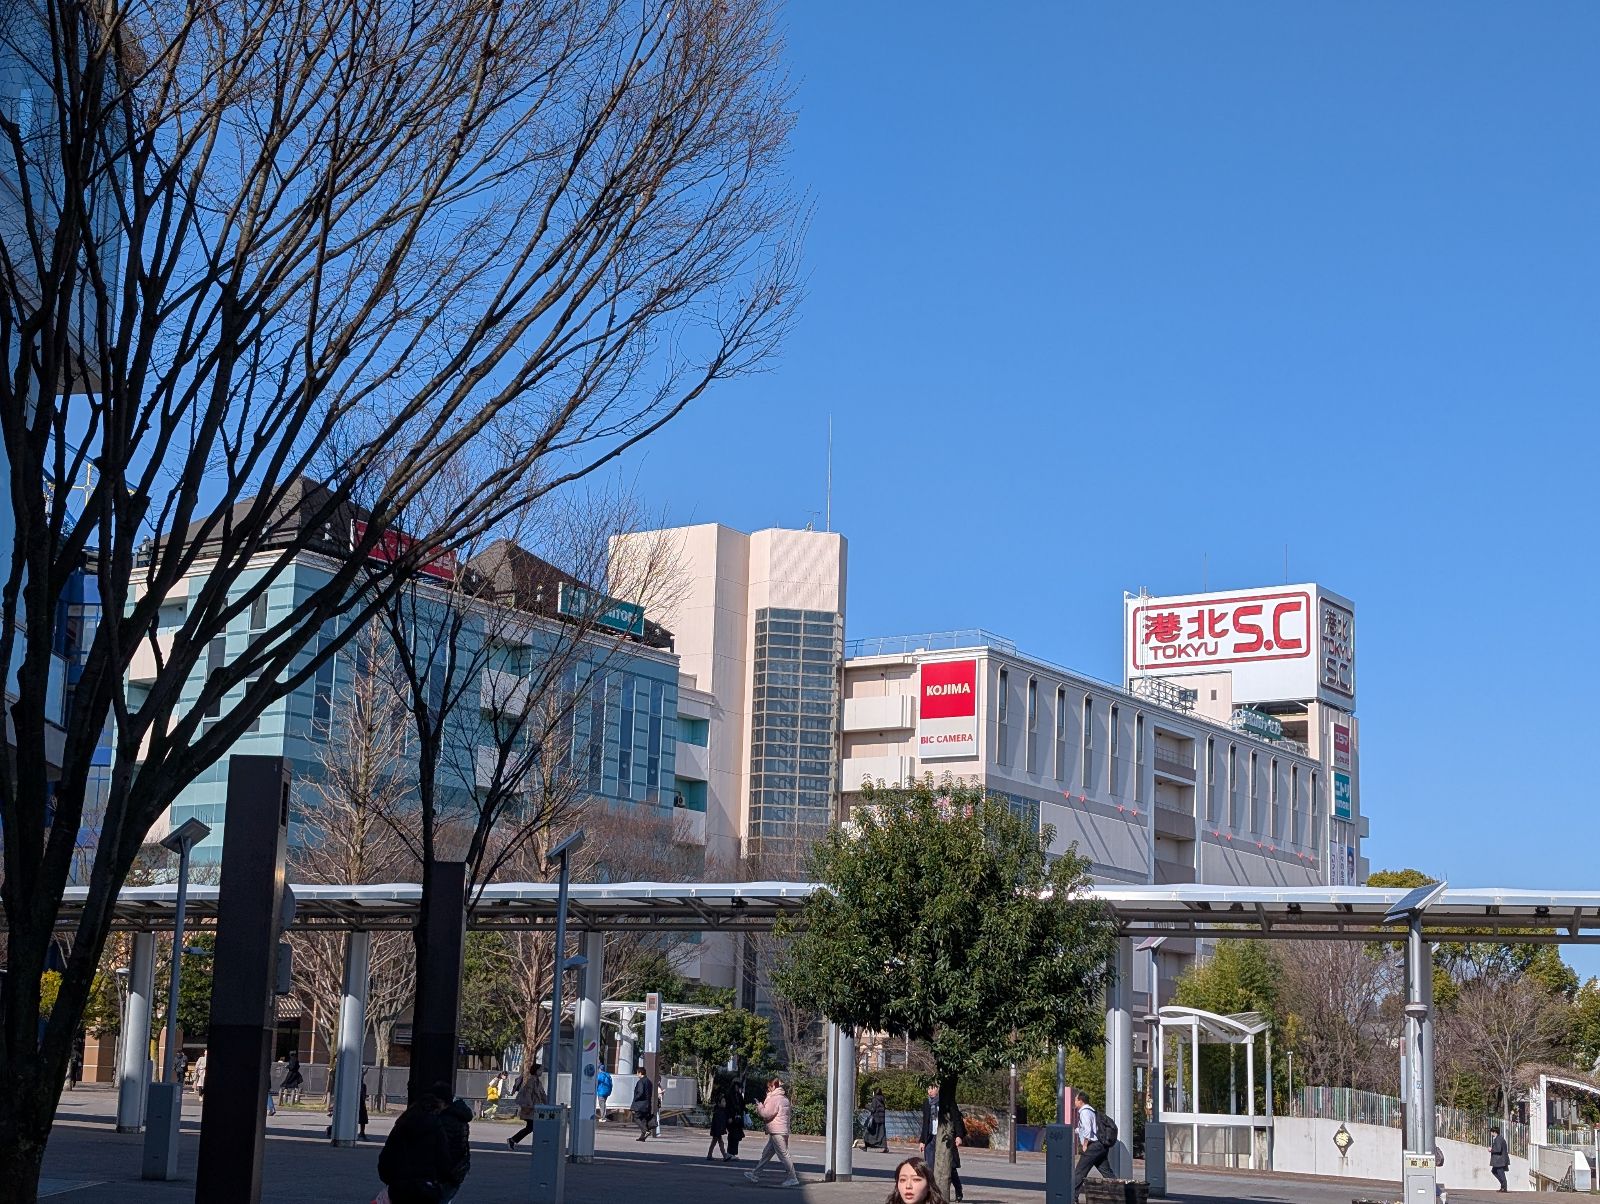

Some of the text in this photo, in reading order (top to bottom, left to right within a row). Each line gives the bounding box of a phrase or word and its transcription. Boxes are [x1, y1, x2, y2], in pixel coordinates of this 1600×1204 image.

[1142, 600, 1302, 653] 港北 S.C
[1325, 608, 1348, 643] 港北
[1150, 641, 1219, 660] TOKYU
[1322, 635, 1352, 663] TOKYU
[926, 682, 971, 696] KOJIMA
[920, 733, 973, 745] BIC CAMERA
